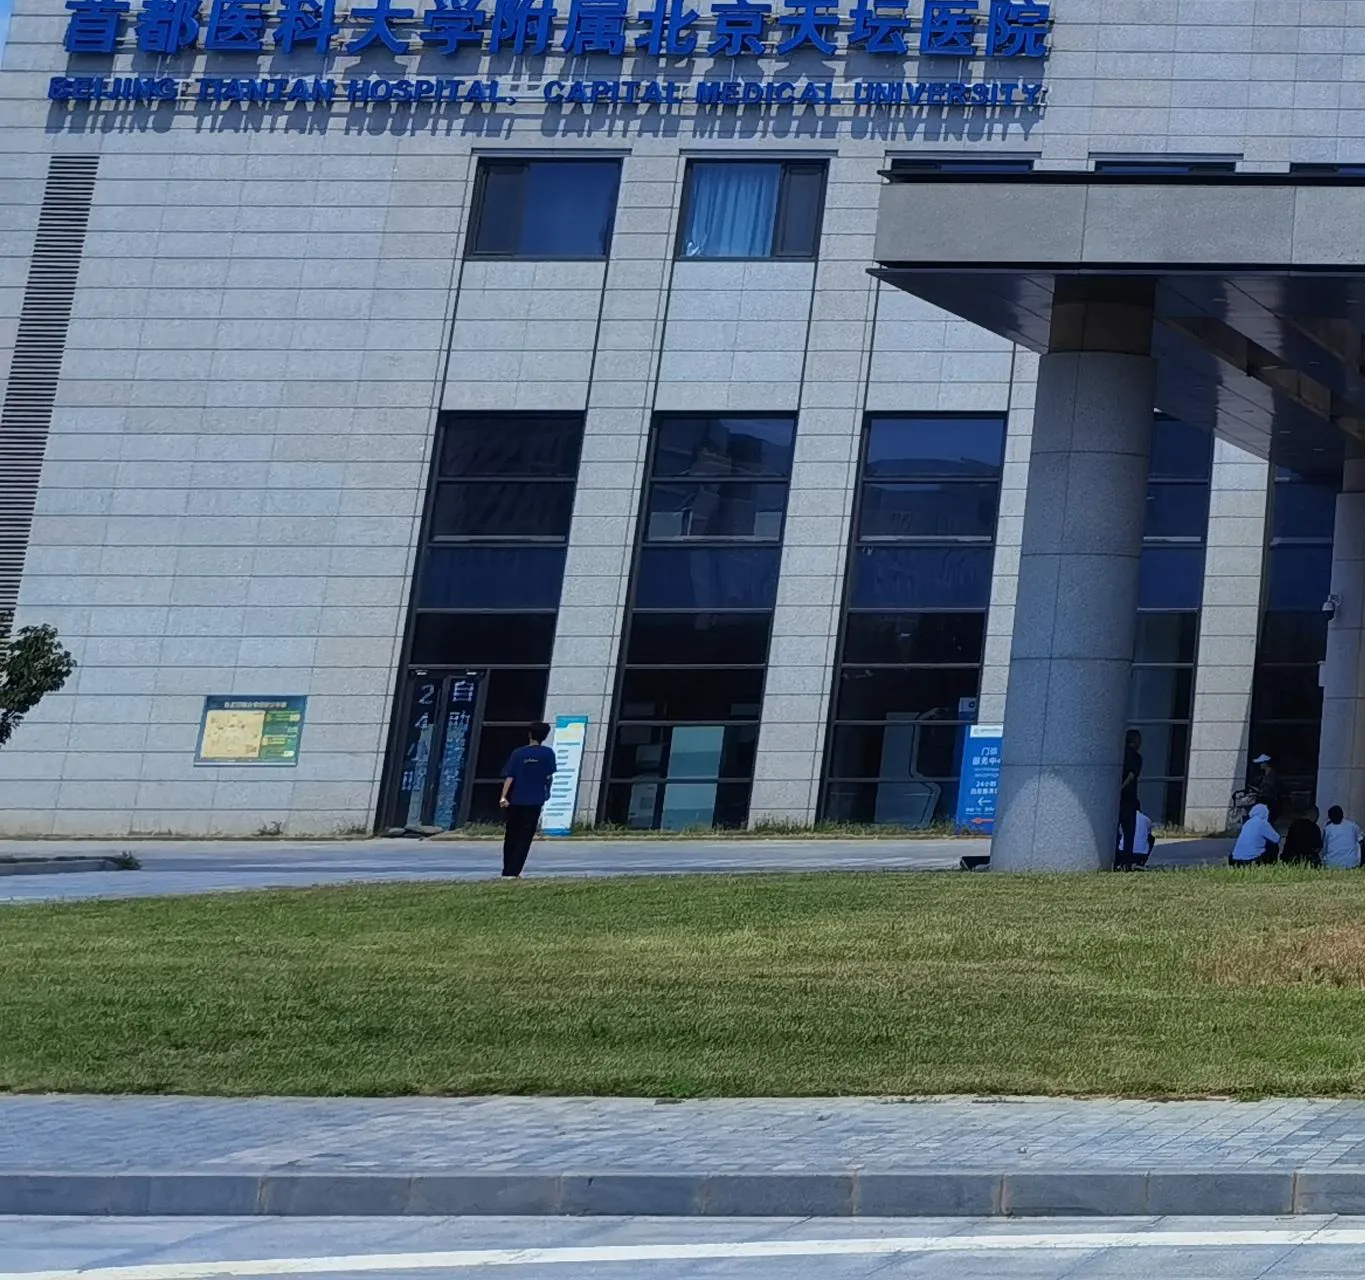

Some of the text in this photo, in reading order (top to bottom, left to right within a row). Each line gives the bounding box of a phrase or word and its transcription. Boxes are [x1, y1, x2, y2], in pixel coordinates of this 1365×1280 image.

[48, 77, 1043, 106] BEIJING TIANTAN HOSPITAL, CAPITAL MEDICAL UNIVERSITY
